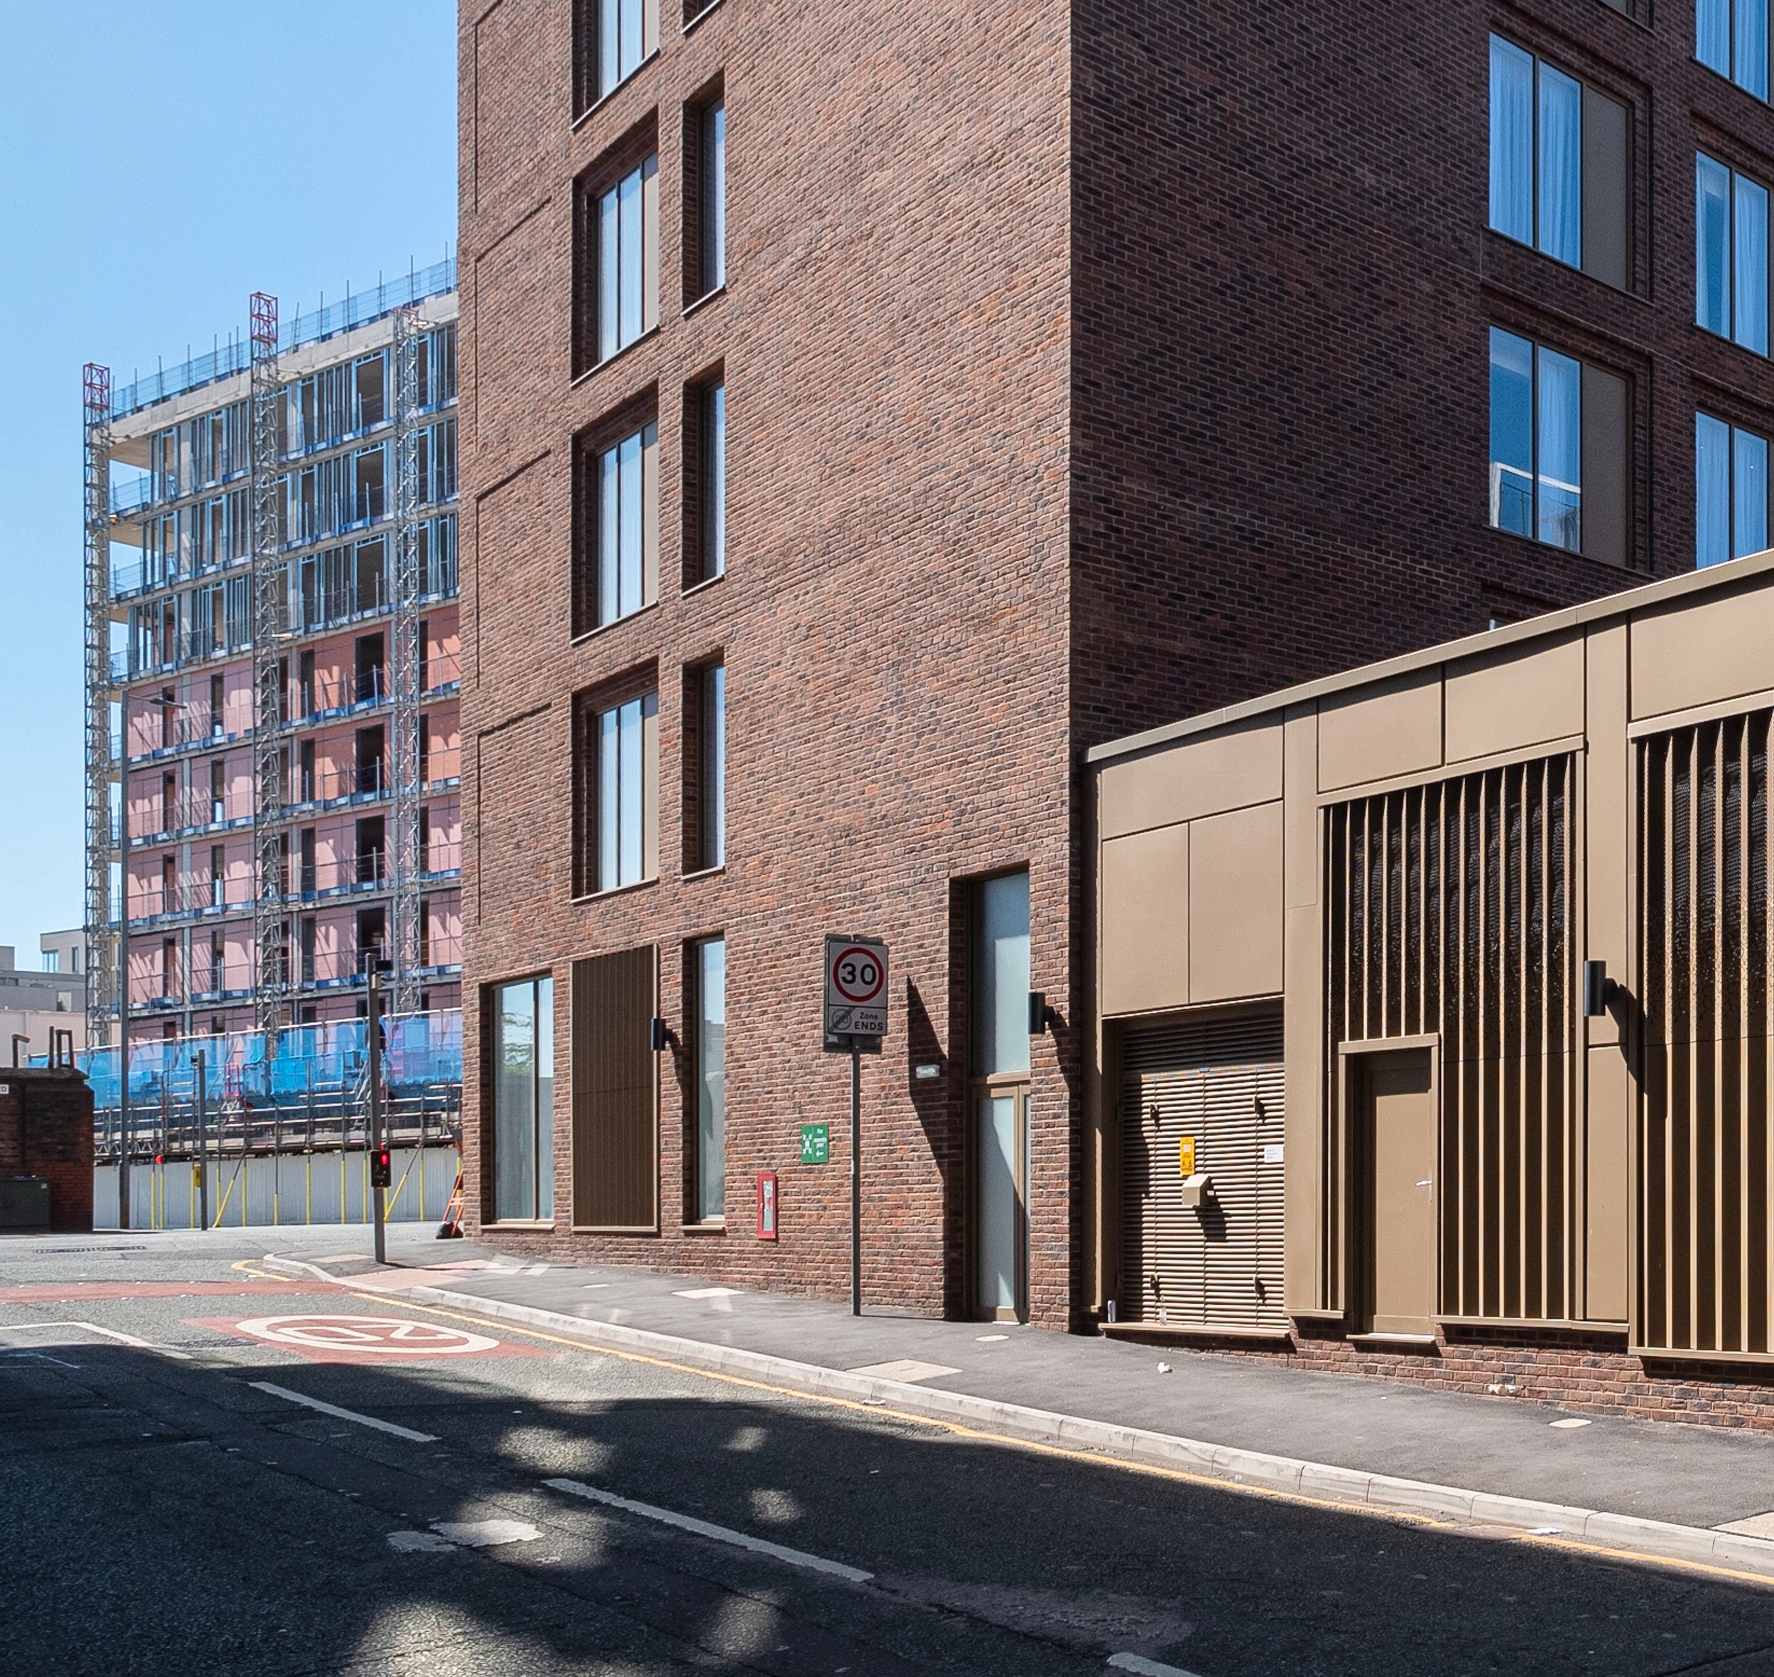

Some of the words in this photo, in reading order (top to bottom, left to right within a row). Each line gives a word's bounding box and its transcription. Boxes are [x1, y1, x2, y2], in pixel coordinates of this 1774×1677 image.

[841, 963, 877, 985] 30
[859, 1011, 878, 1020] Zone
[854, 1021, 884, 1031] ENDS
